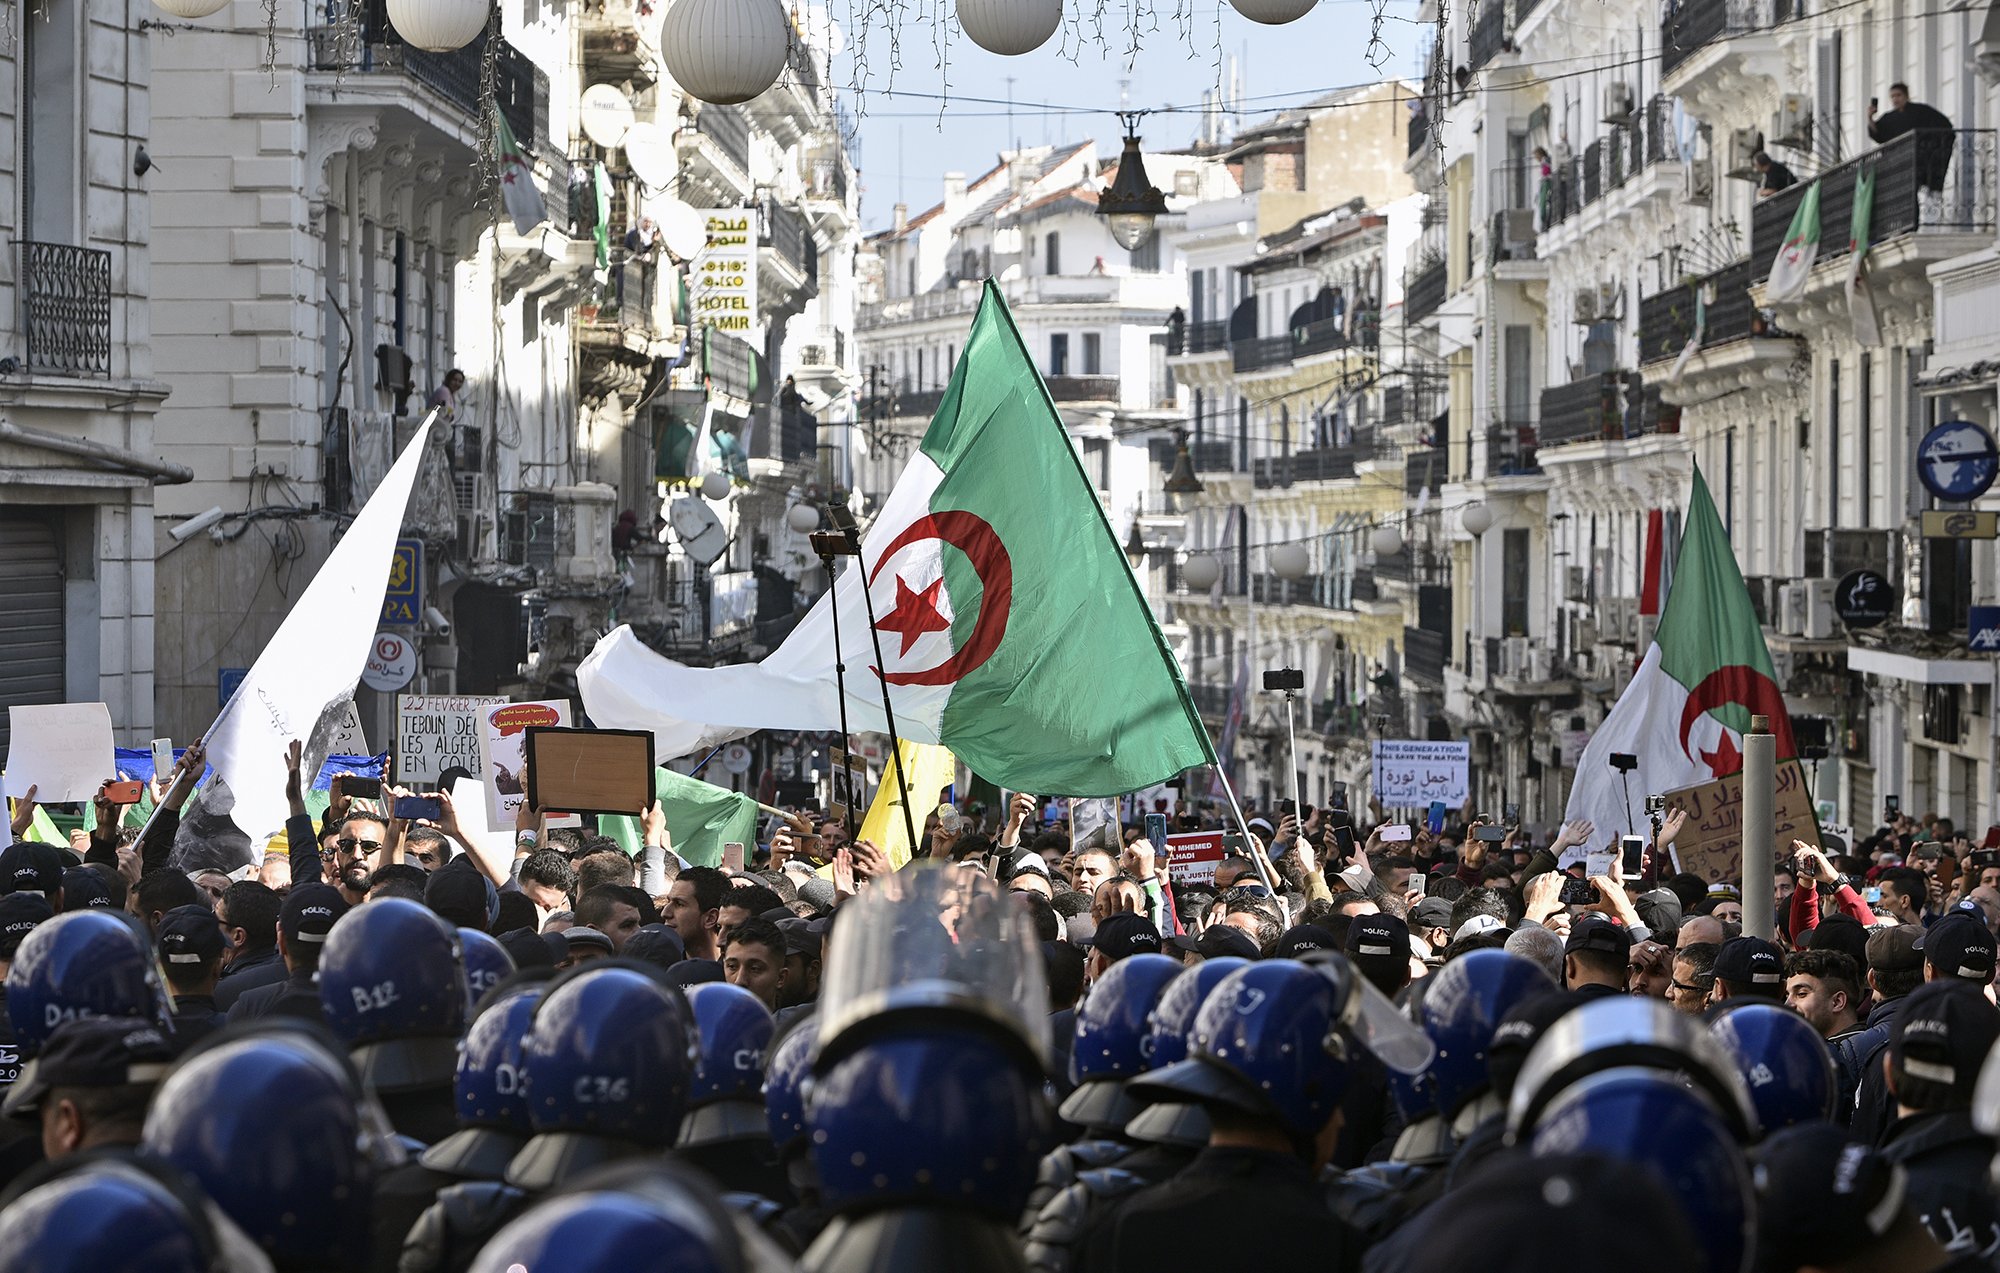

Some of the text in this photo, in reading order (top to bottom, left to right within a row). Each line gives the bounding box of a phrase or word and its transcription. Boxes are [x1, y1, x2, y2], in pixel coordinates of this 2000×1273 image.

[697, 296, 749, 310] HOTEL
[384, 601, 414, 619] PA
[403, 696, 425, 710] 22
[402, 715, 446, 735] TEBOUN
[402, 735, 423, 754] LES
[1380, 744, 1463, 753] THIS GENERATION
[405, 756, 426, 772] EN
[503, 797, 522, 811] لحاج
[1178, 842, 1212, 851] MHEMED
[14, 867, 39, 878] POLICE
[1170, 864, 1189, 872] ERTÉ
[1188, 871, 1215, 879] JUSTIC
[301, 906, 332, 916] POLICE
[1480, 918, 1500, 929] LA
[1362, 928, 1390, 937] POLICE
[1965, 946, 1990, 955] POLICE
